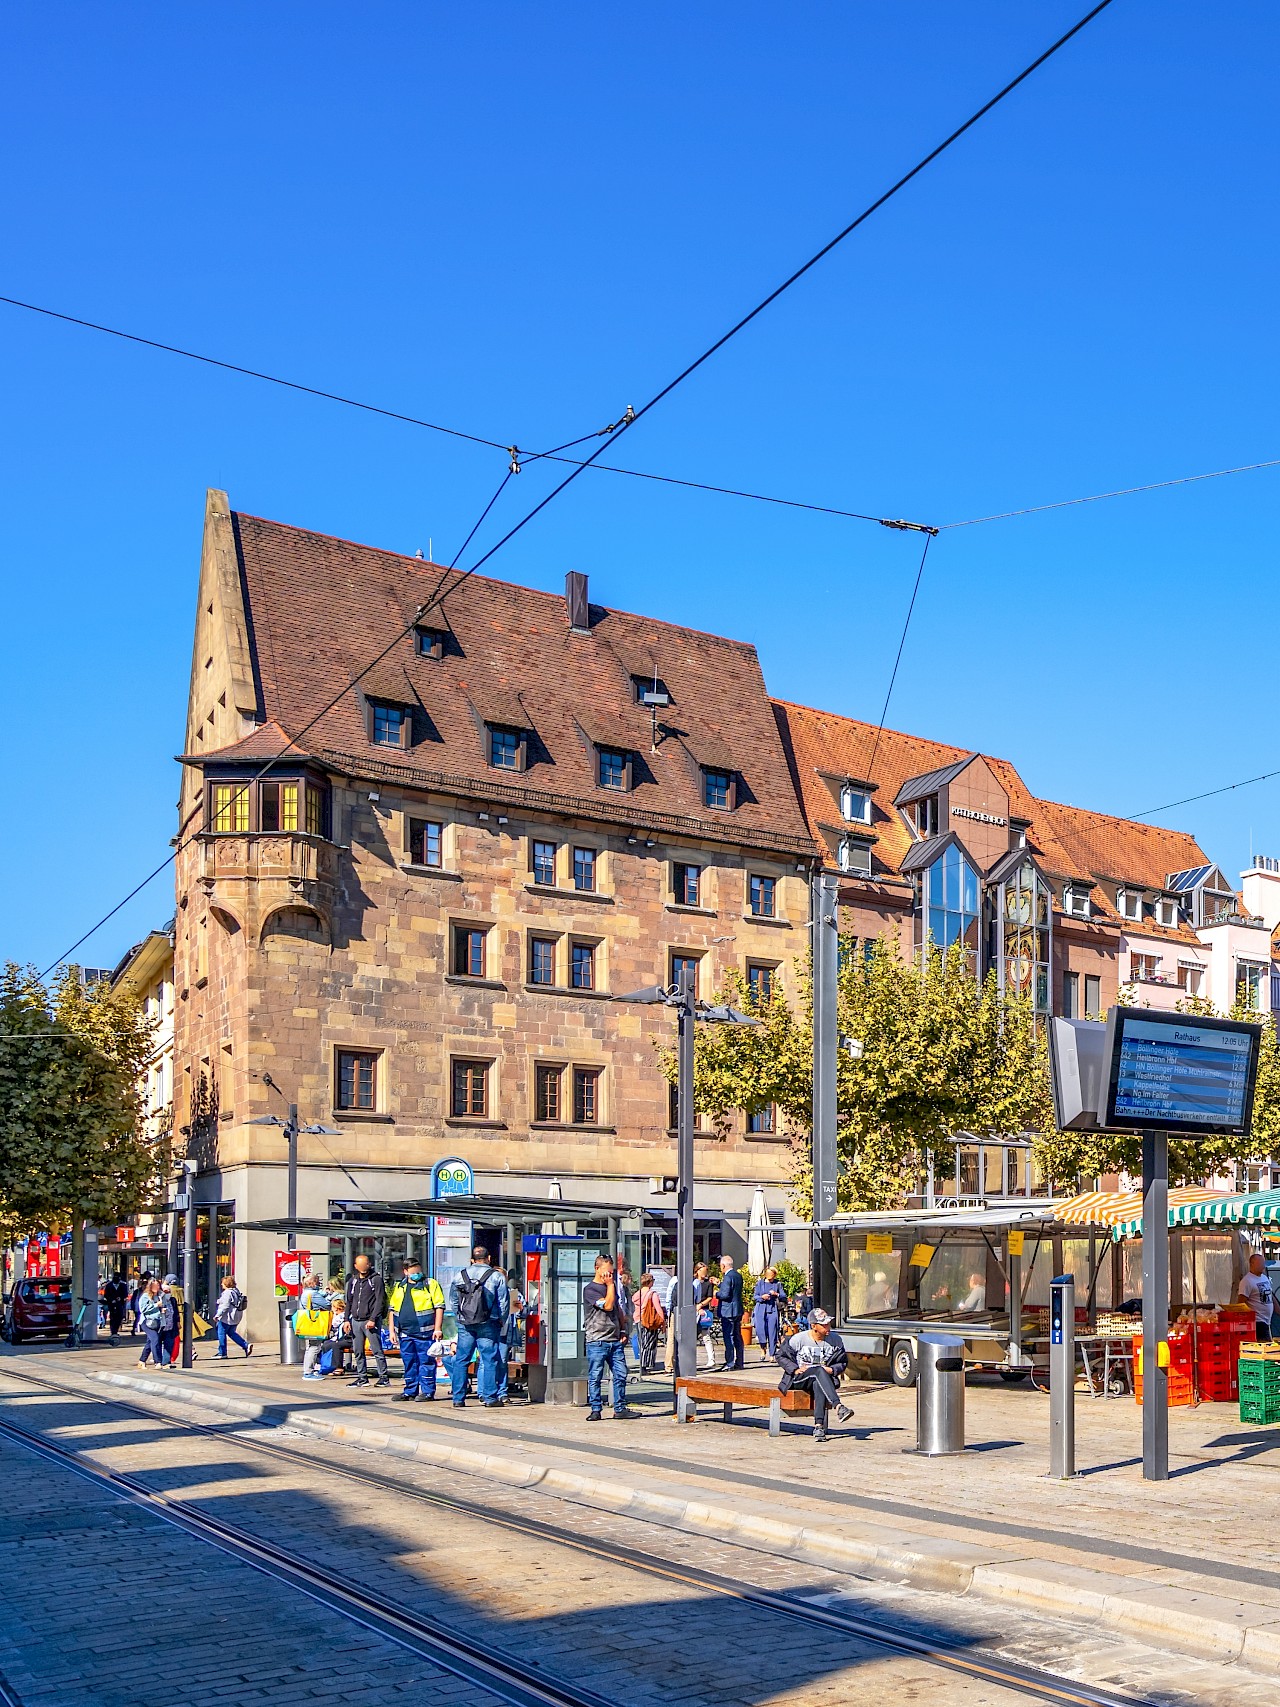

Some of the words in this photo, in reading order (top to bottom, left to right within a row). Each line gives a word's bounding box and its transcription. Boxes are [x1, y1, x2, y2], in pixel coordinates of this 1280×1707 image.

[1174, 1031, 1201, 1043] Rathaus
[1237, 1039, 1249, 1047] Uhr
[1136, 1053, 1165, 1063] Heilbronn
[1166, 1056, 1178, 1065] Hbf
[1135, 1061, 1146, 1070] HN
[1134, 1071, 1172, 1082] Westfriedhof
[1131, 1097, 1160, 1107] Heilbronn
